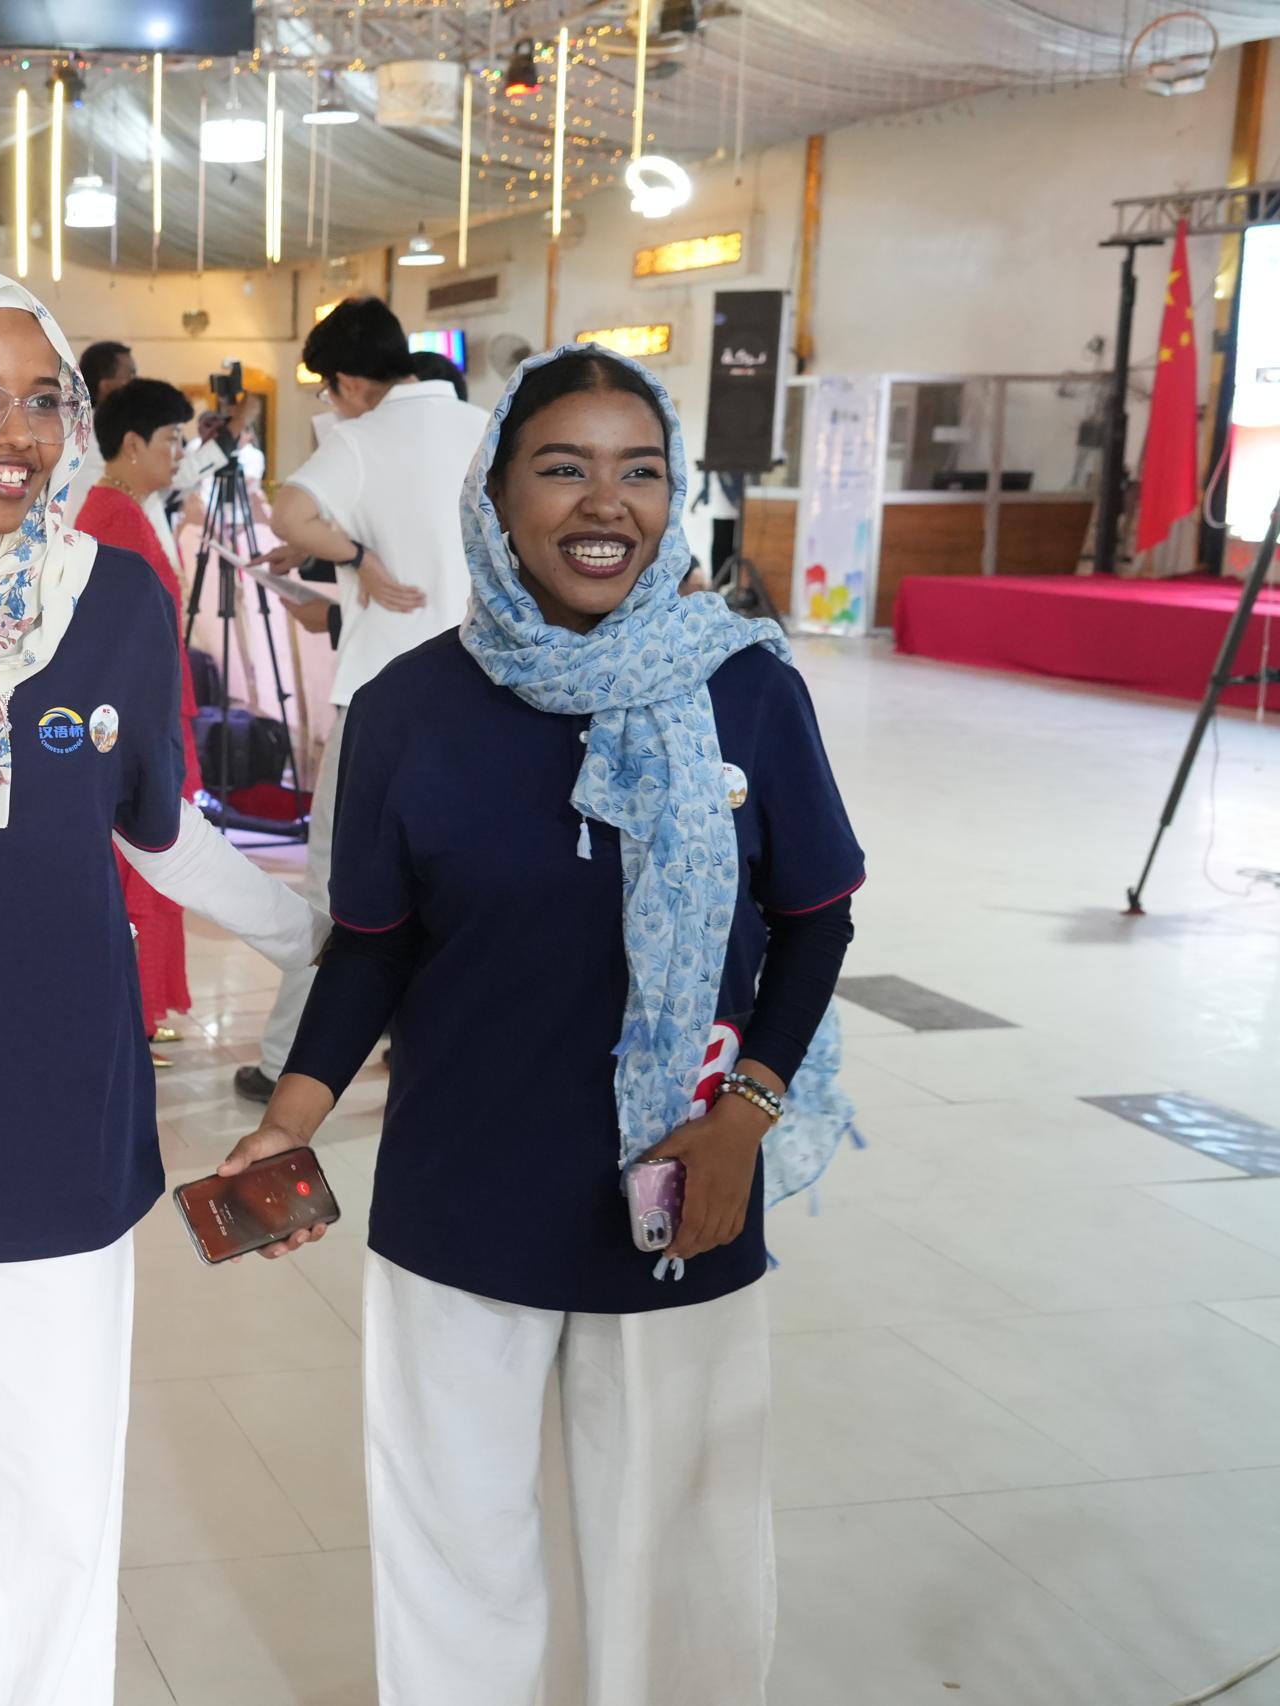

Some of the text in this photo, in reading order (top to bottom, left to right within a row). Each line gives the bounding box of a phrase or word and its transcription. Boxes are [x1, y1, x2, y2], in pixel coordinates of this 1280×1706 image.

[39, 725, 85, 739] 汉语桥
[41, 738, 84, 754] CHINESE BRIDGE
